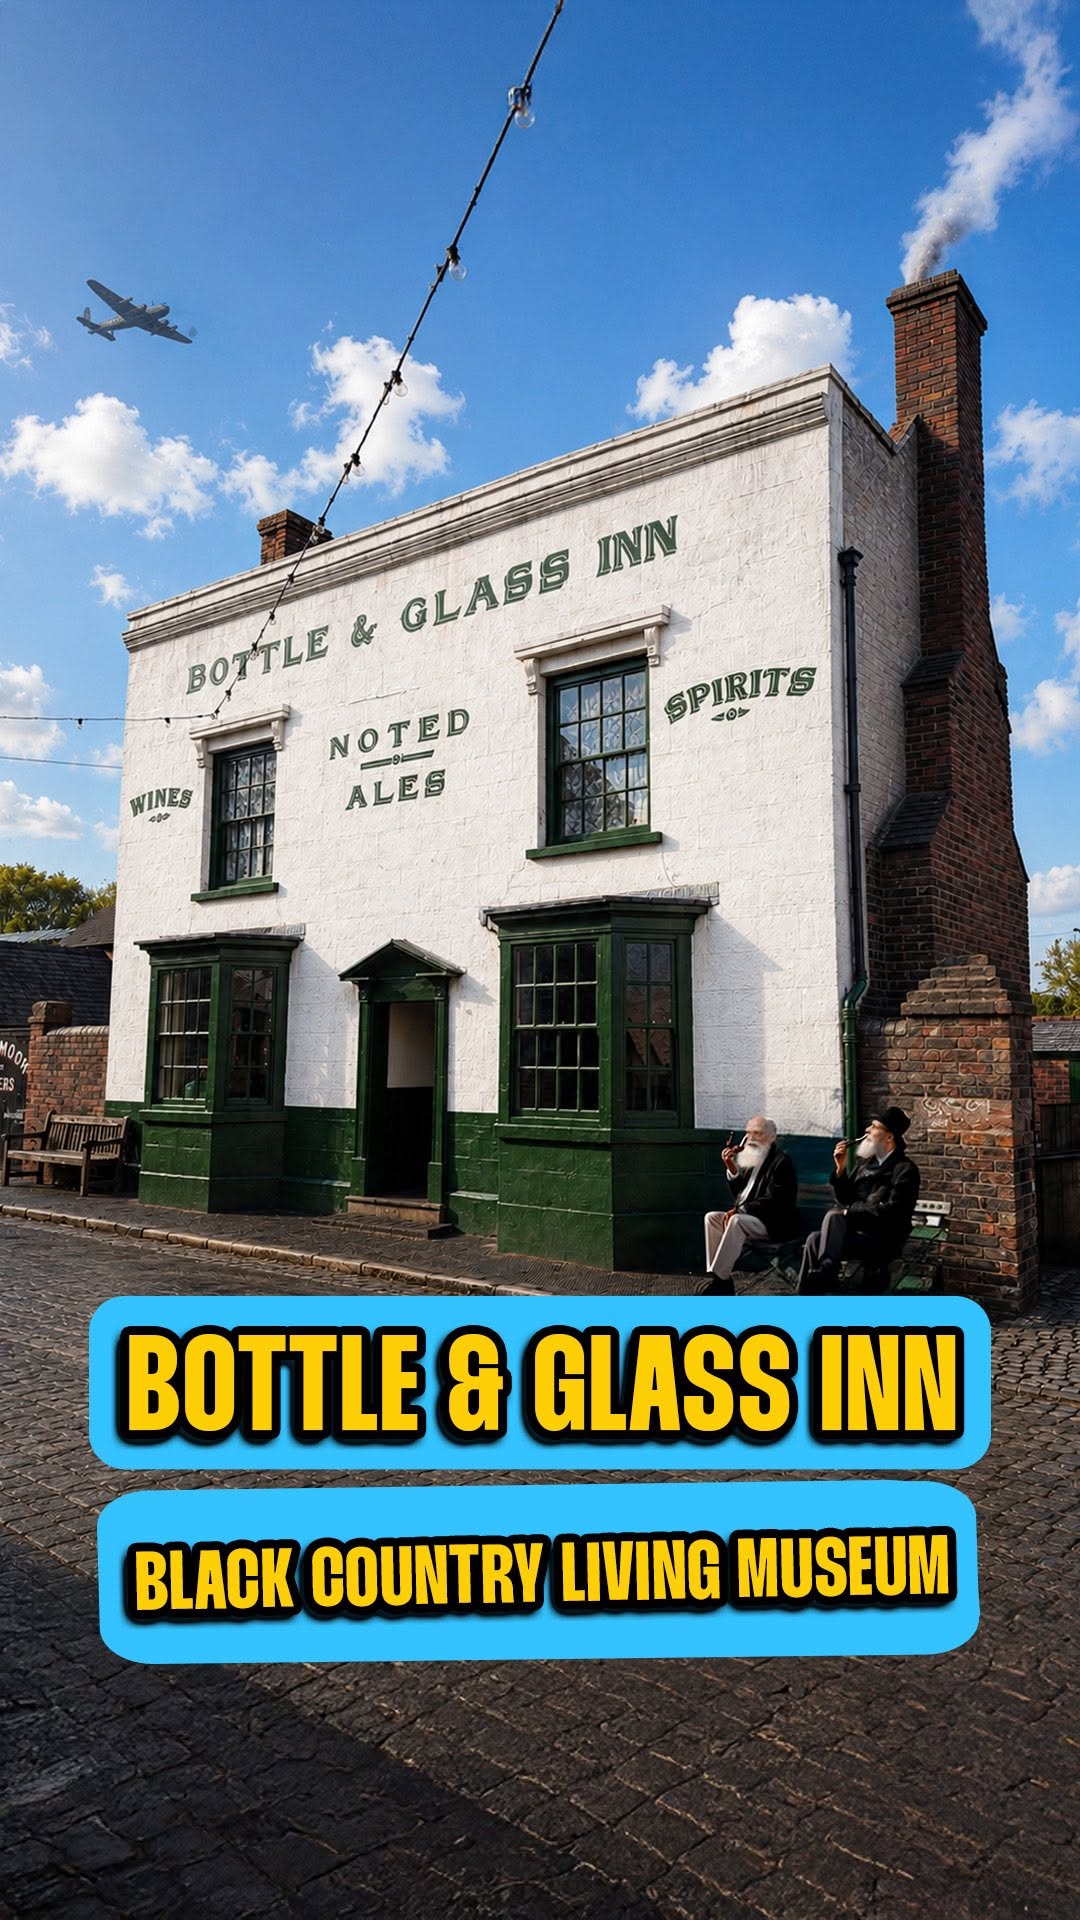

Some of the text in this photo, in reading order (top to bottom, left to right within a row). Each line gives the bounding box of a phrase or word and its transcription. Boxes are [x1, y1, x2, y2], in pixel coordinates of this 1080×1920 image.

[186, 514, 678, 694] BOTTLE & GLASS INN
[664, 667, 817, 724] SPIRITS
[329, 708, 470, 760] NOTED
[129, 787, 194, 817] WINES
[345, 769, 446, 811] ALES
